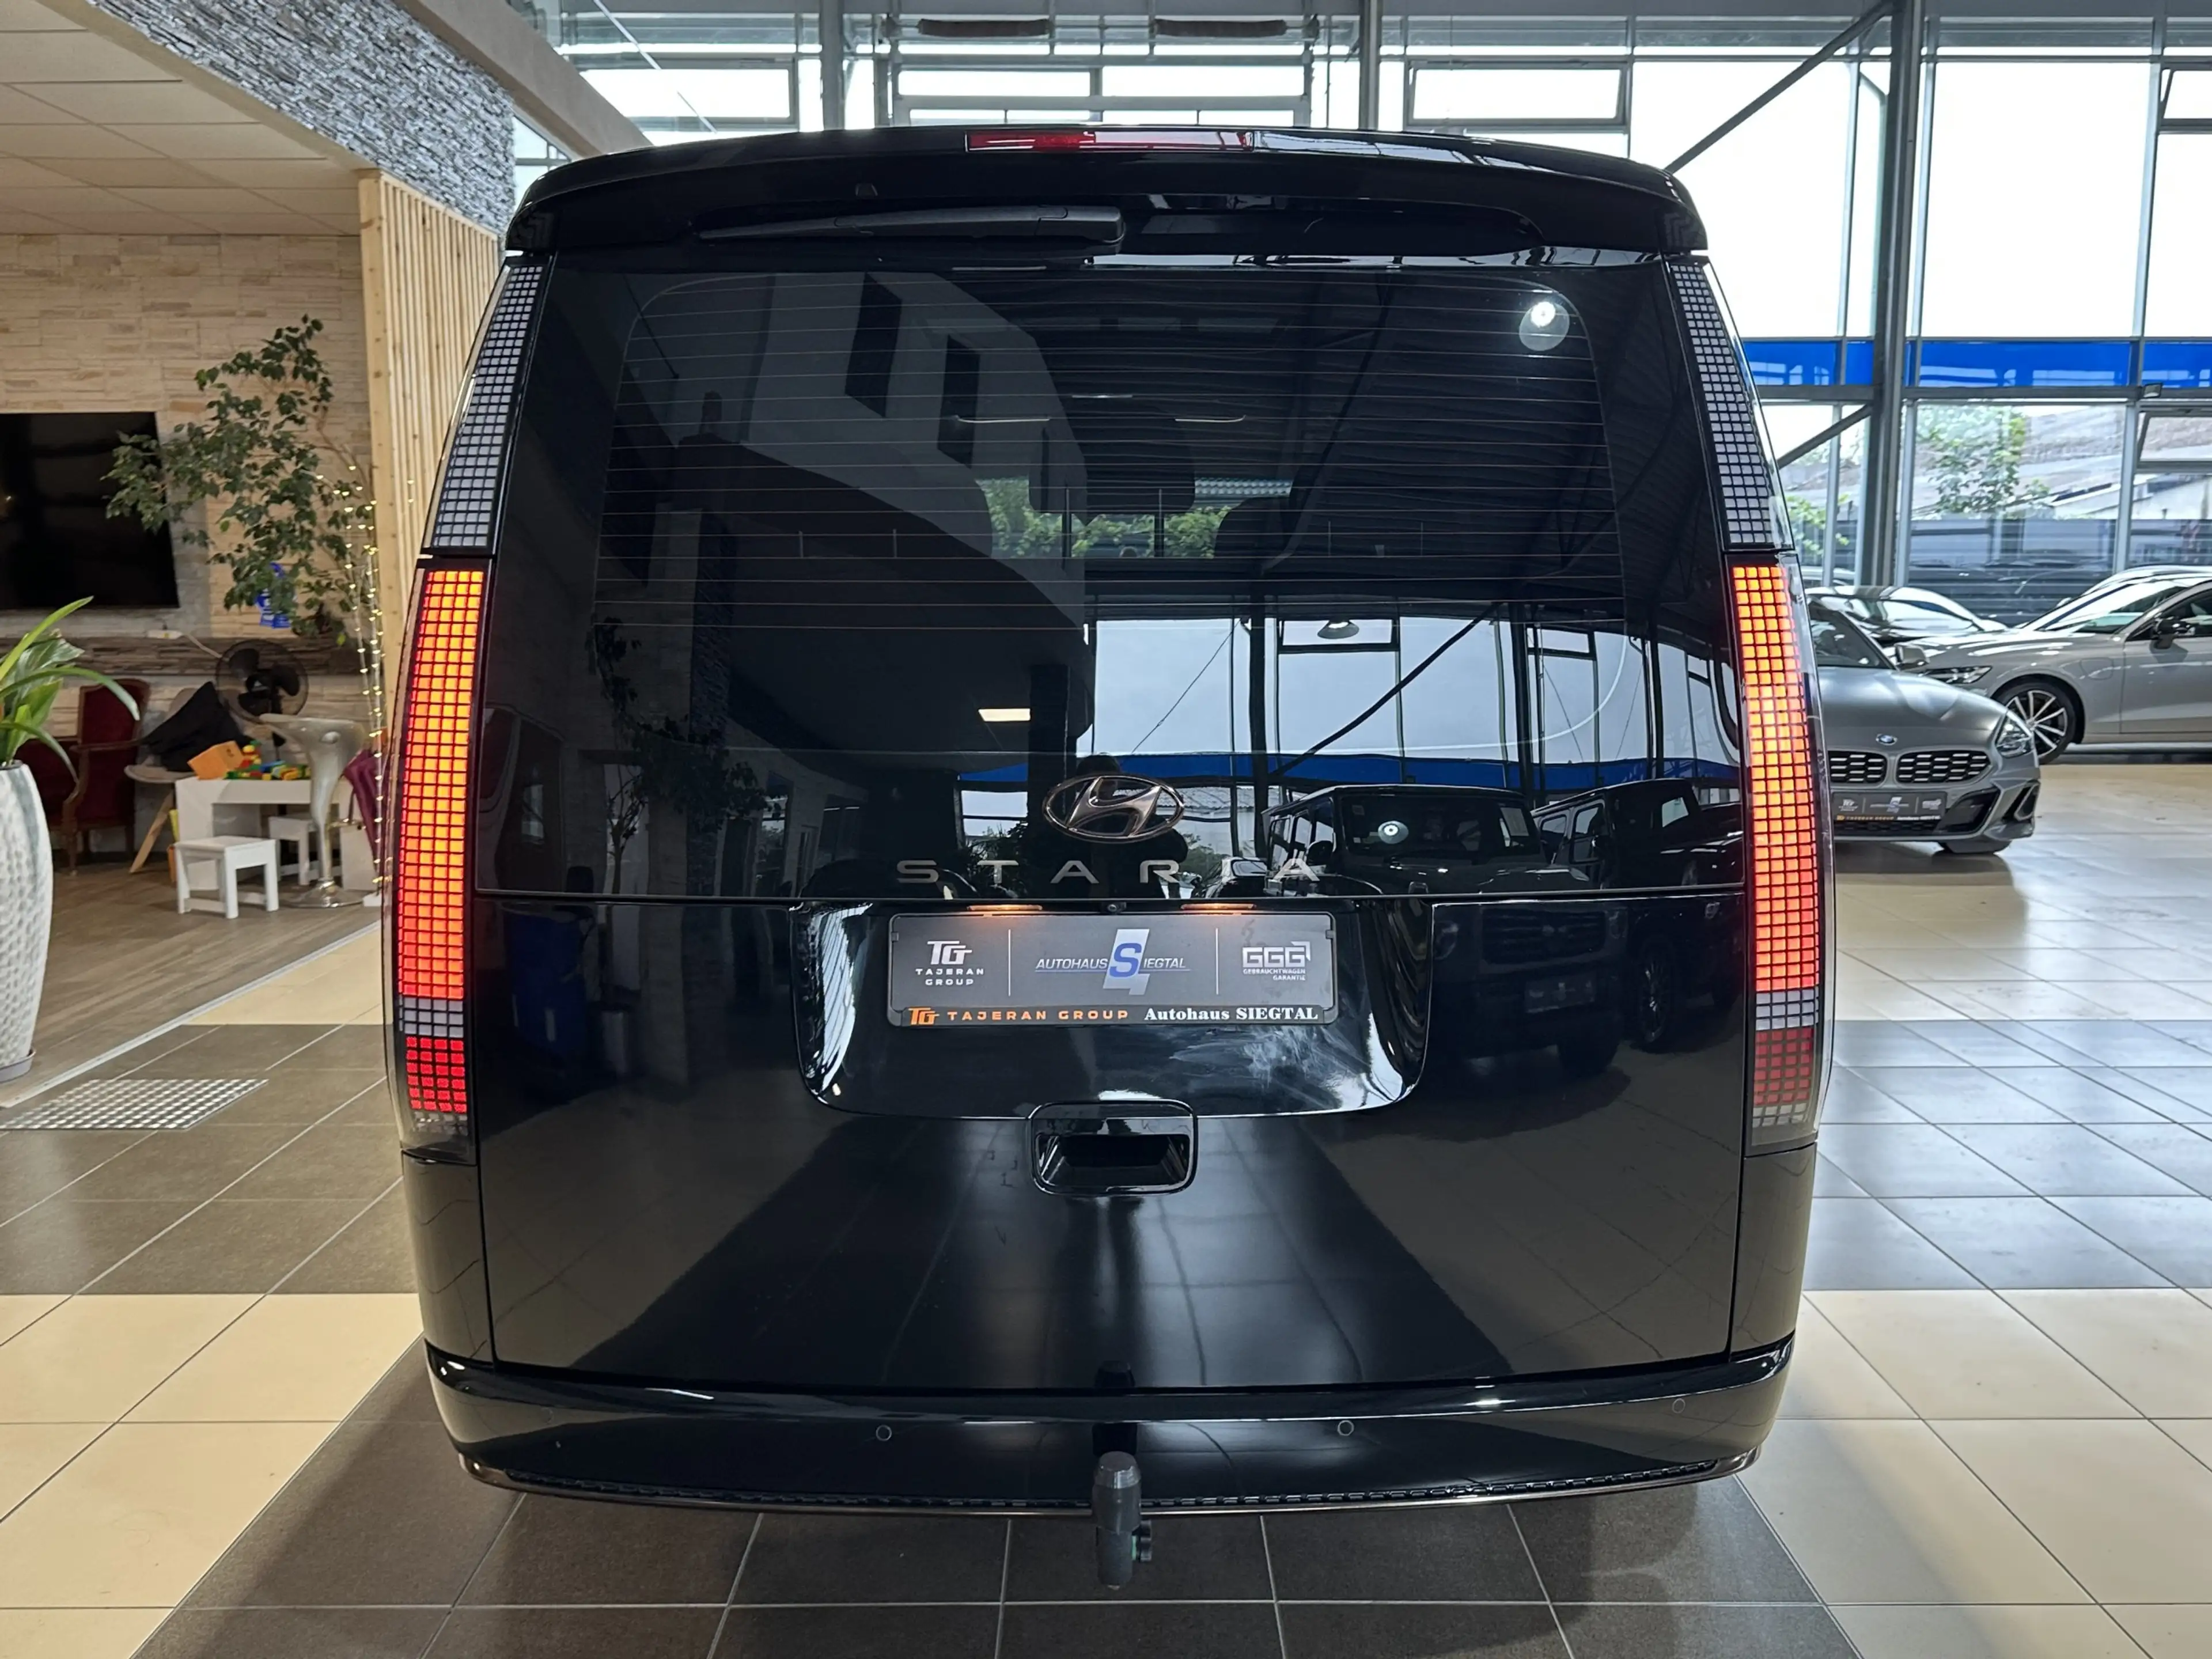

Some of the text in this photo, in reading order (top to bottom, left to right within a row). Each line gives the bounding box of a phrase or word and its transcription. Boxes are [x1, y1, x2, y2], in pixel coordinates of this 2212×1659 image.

[1036, 958, 1108, 969] AUTOHAUS
[1242, 946, 1305, 968] GGG
[947, 1011, 1046, 1020] TAJERAN
[1058, 1010, 1128, 1020] GROUP
[1144, 1008, 1230, 1021] Autohaus
[1236, 1007, 1318, 1021] SIEGTAL
